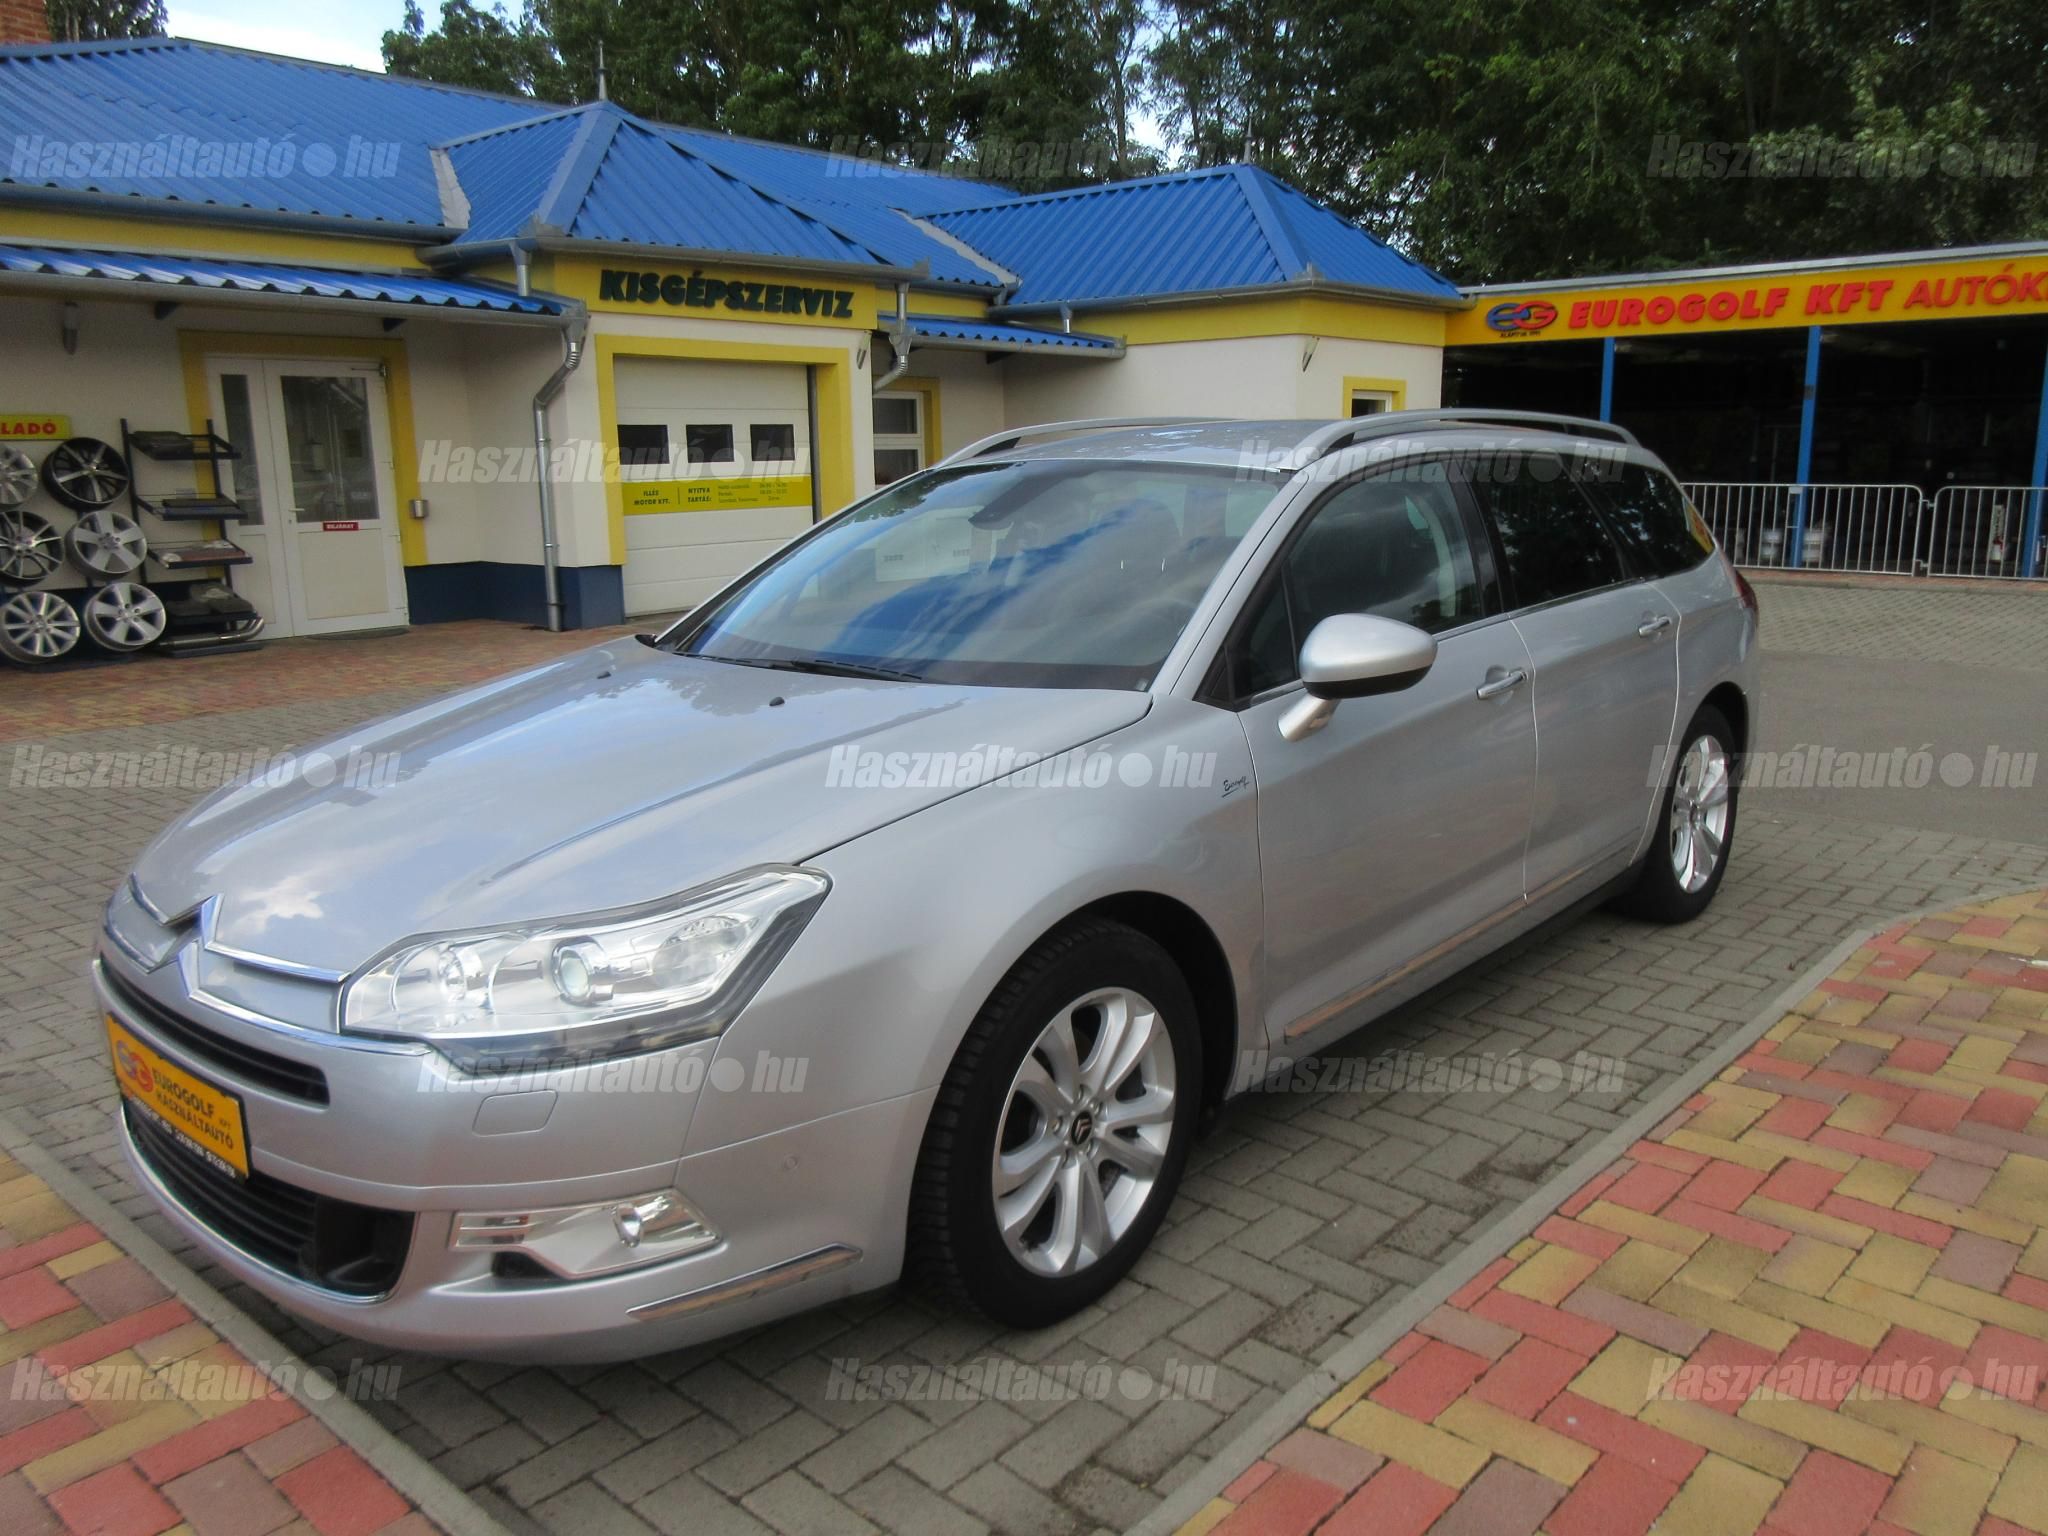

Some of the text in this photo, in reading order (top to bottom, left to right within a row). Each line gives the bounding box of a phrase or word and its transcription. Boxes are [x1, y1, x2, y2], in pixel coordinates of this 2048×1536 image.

[600, 269, 854, 318] KISGÉPSZERVIZ
[1568, 263, 2048, 329] EUROGOLF KFT AUTÓK
[1, 418, 57, 434] LADÓ
[152, 1067, 215, 1118] EUROGOLF
